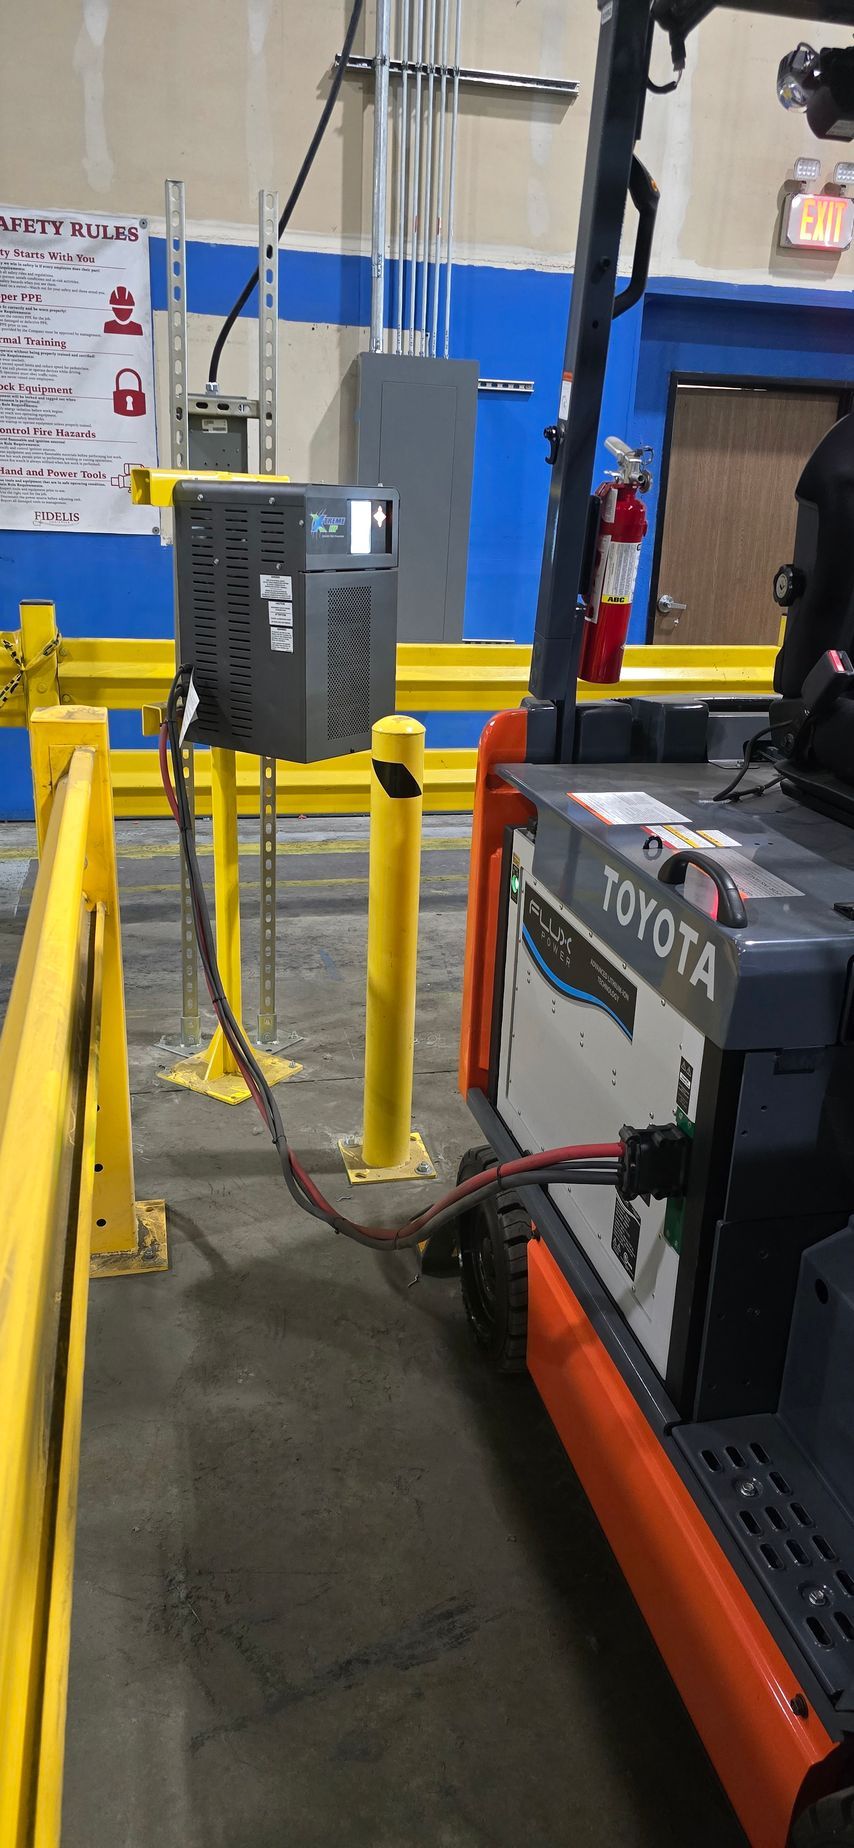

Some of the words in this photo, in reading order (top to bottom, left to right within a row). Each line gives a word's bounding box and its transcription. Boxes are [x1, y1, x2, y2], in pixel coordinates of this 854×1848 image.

[799, 198, 846, 242] EXIT
[70, 221, 139, 242] RULES
[13, 248, 45, 259] Starts
[48, 251, 73, 262] With
[76, 254, 95, 263] You
[20, 293, 43, 303] PPE
[23, 337, 67, 349] Training
[18, 383, 73, 396] Equipment
[33, 427, 53, 436] Fire
[56, 429, 96, 438] Hazards
[26, 468, 44, 476] and
[47, 469, 78, 478] Power
[80, 470, 107, 479] Tools
[34, 511, 80, 522] FIDELIS
[607, 594, 625, 603] ABC
[529, 899, 572, 955] FLUX
[603, 864, 716, 1002] TOYOTA
[541, 930, 571, 968] POWER
